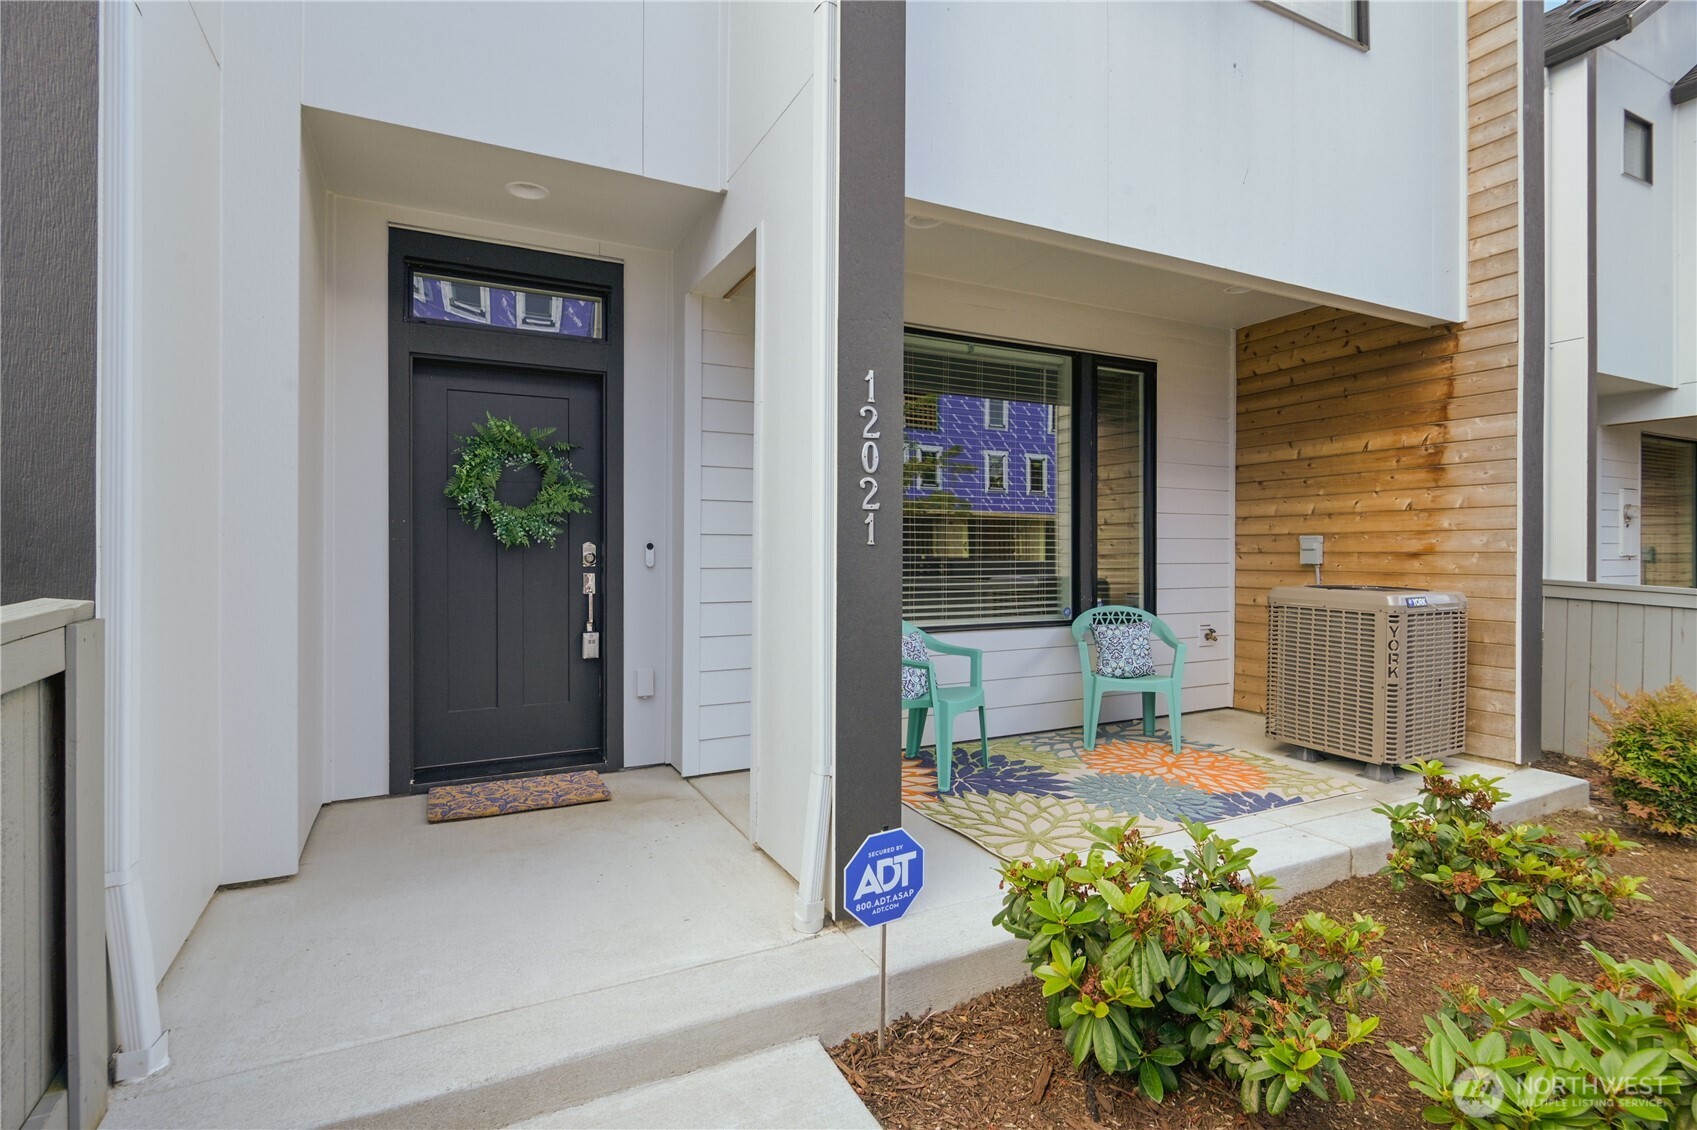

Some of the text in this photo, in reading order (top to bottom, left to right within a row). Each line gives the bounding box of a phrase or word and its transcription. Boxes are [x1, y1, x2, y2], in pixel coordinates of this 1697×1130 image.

[859, 369, 881, 546] 12021
[1387, 625, 1400, 679] YORK
[867, 844, 904, 858] SECURED BY
[853, 850, 917, 901] ADT
[855, 888, 915, 912] 800.ADT.ASAP
[871, 902, 900, 915] ADT.COM
